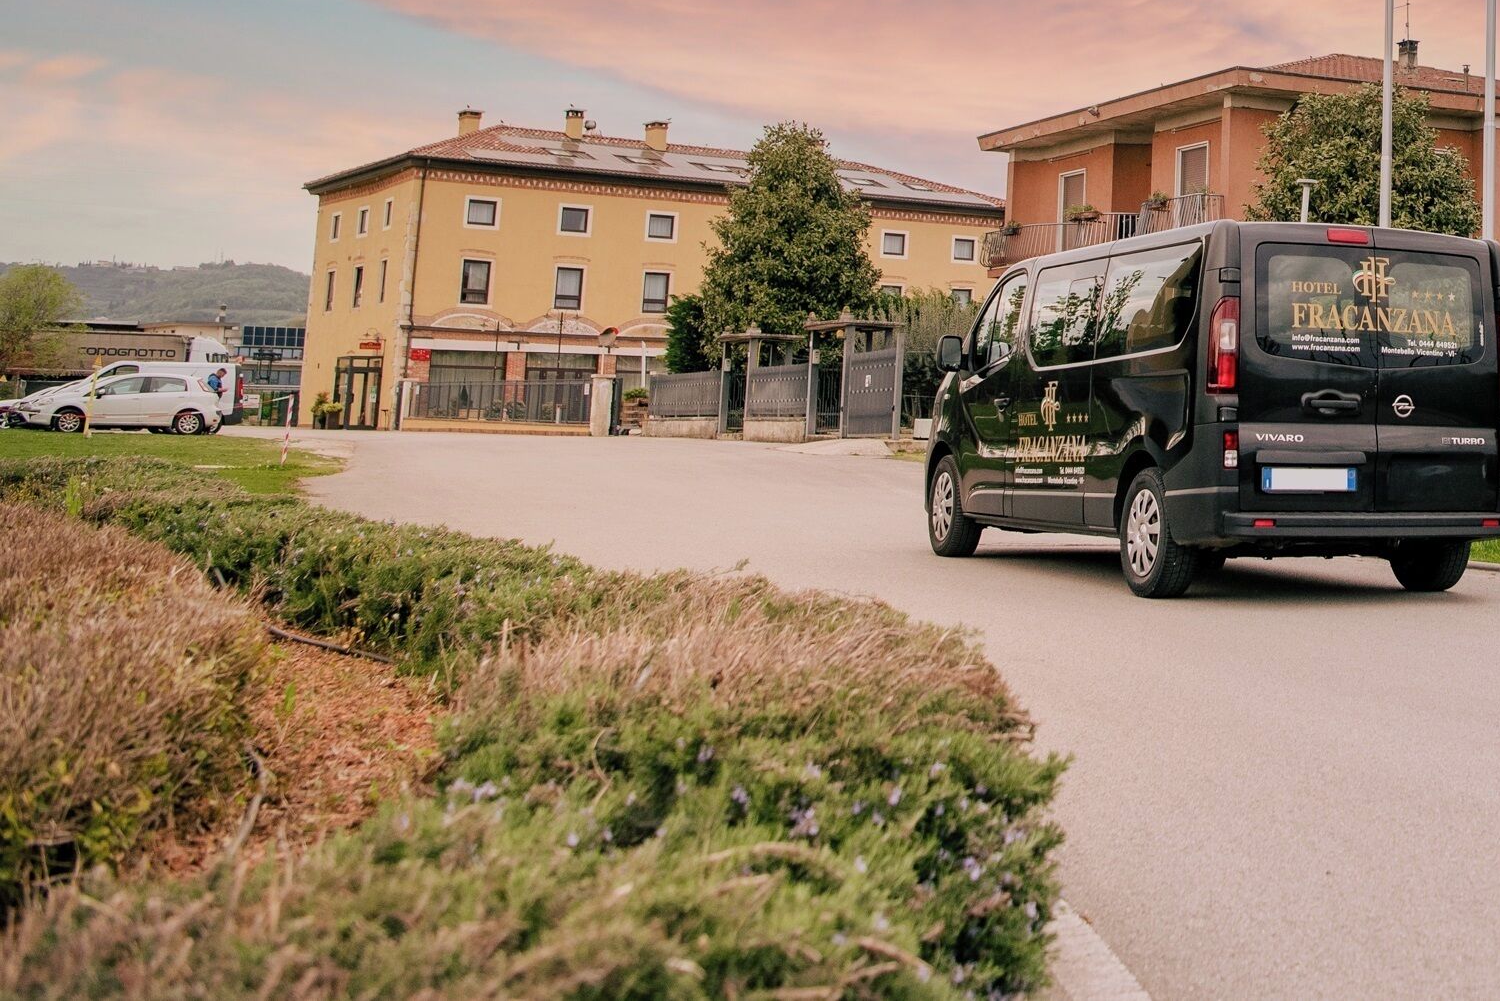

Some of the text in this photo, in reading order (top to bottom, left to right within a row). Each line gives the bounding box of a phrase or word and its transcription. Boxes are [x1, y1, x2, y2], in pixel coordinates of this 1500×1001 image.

[1291, 280, 1342, 295] HOTEL
[1291, 302, 1457, 336] FRACANZANA
[1291, 333, 1360, 344] info@fracanzana.com
[1291, 343, 1361, 352] www.fracanzana.com
[1018, 413, 1039, 426] HOTEL
[1255, 433, 1305, 443] VIVARO
[1015, 434, 1086, 463] FRACANZANA
